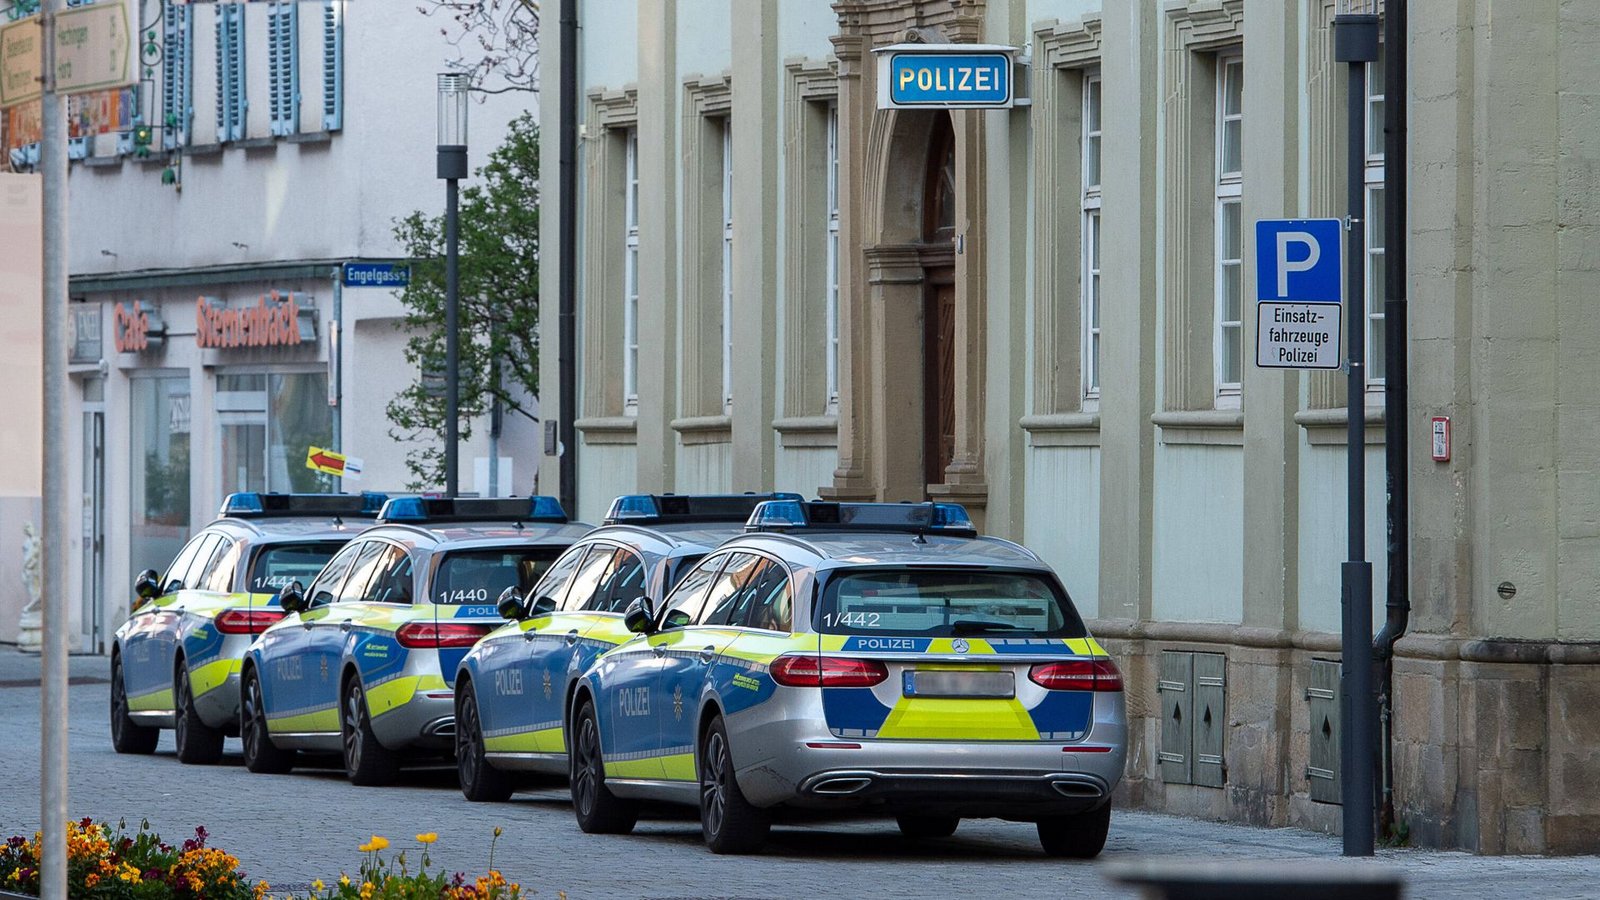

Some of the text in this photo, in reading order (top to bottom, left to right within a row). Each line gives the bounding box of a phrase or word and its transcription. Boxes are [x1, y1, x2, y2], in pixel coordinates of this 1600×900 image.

[900, 67, 999, 91] POLIZEI
[1277, 231, 1320, 297] P
[196, 289, 301, 348] Sternenbäck
[1274, 308, 1324, 323] Einsatz-
[1269, 328, 1329, 346] fahrzeuge
[1279, 347, 1318, 363] Polizei
[440, 589, 487, 603] 1/440
[468, 607, 499, 615] POLI
[823, 612, 880, 627] 1/442
[858, 639, 915, 649] POLIZEI
[495, 669, 523, 696] POLIZEI
[619, 687, 650, 717] POLIZEI
